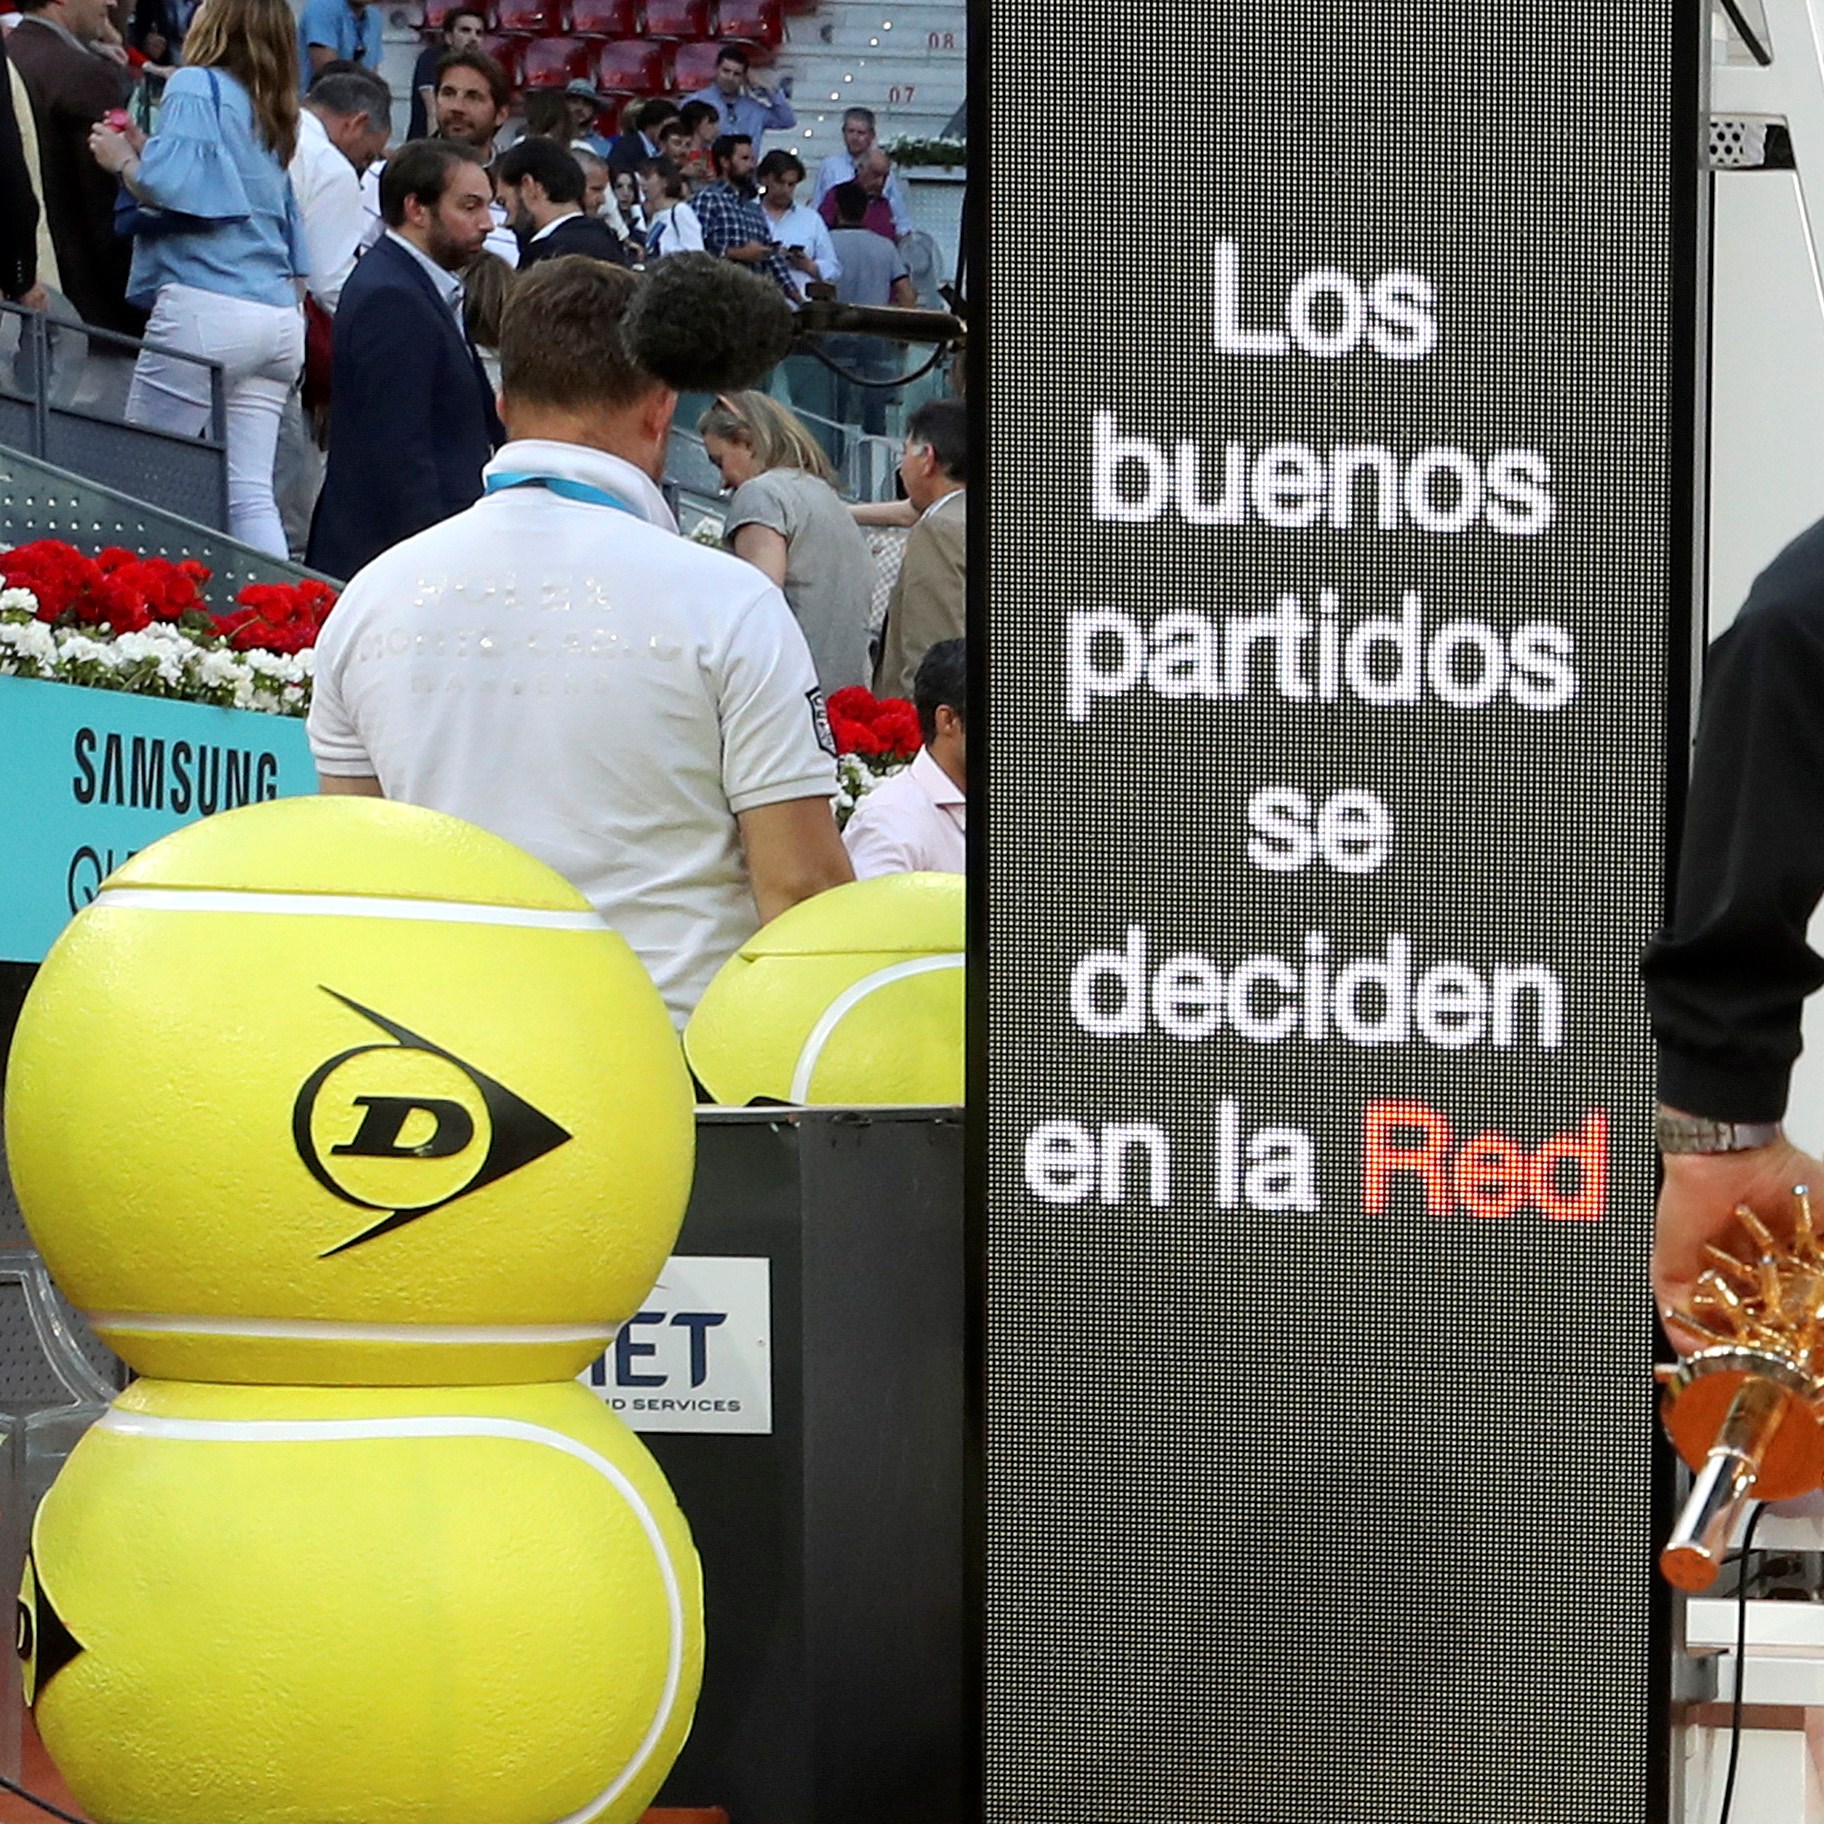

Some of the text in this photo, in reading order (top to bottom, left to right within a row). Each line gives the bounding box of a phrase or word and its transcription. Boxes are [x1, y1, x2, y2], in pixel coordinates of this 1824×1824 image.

[928, 32, 955, 49] 08
[889, 86, 915, 103] 07
[1213, 240, 1437, 362] Los
[1092, 410, 1554, 536] buenos
[1066, 591, 1577, 722] partidos
[73, 727, 278, 816] SAMSUNG
[1247, 784, 1393, 875] se
[1069, 924, 1564, 1050] deciden
[1022, 1097, 1609, 1223] en la Red
[633, 1399, 741, 1412] SERVICES
